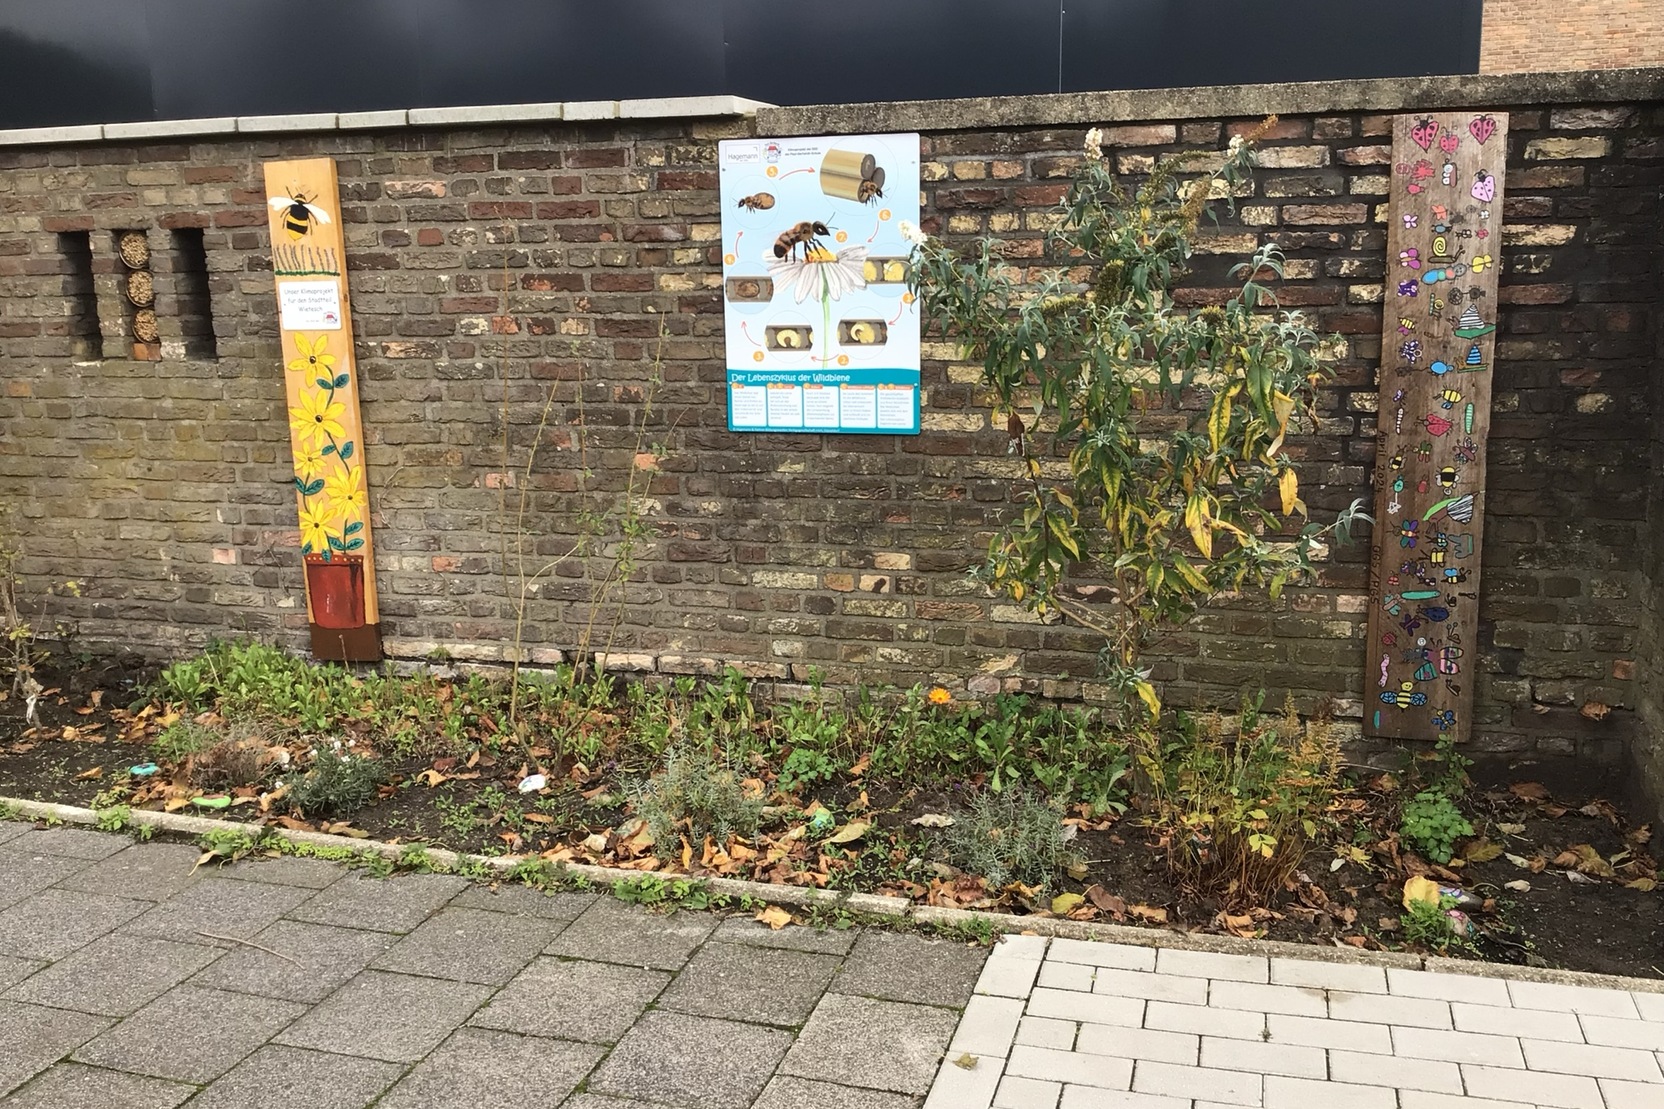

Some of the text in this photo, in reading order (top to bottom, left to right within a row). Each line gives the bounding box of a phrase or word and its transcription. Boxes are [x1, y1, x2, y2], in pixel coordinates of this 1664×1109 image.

[728, 153, 758, 161] Hagemann
[731, 373, 851, 383] Der Lebenszyklus der Wildbiene
[1378, 431, 1388, 457] April
